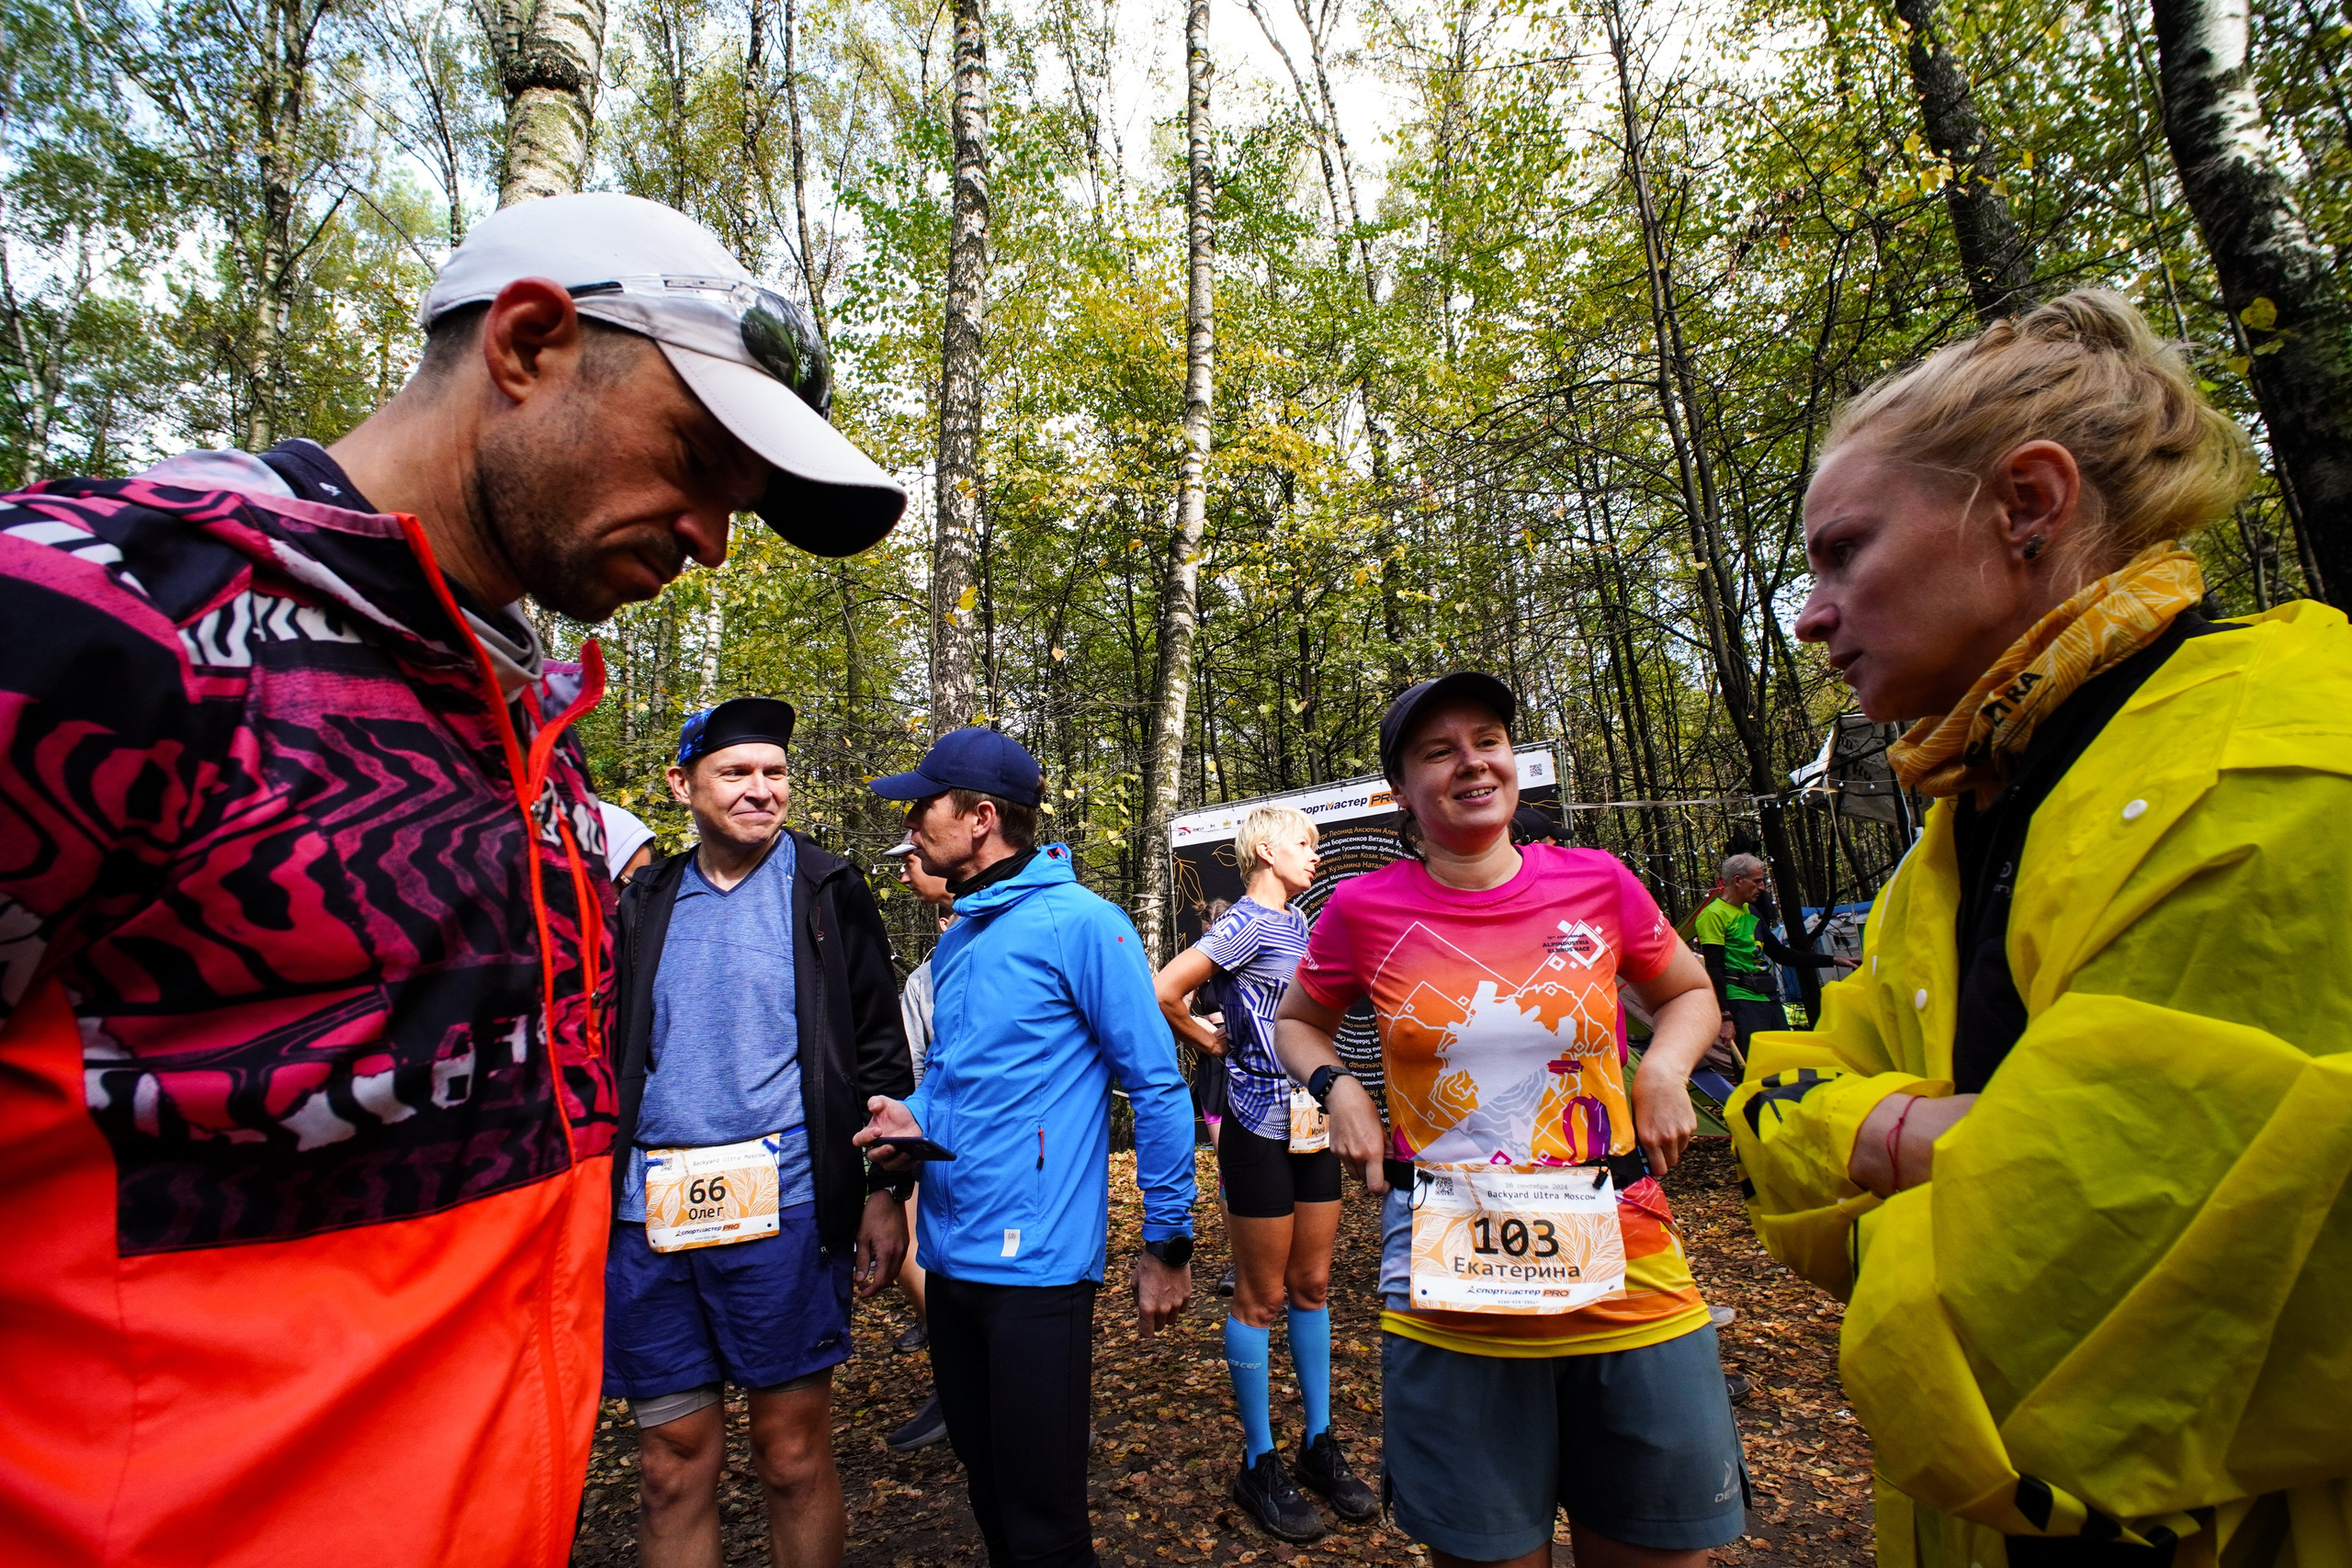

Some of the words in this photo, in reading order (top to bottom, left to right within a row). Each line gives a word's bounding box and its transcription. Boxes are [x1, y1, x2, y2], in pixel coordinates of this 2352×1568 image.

[1329, 829, 1353, 837] Леонид
[1331, 836, 1368, 846] Борисенков
[1369, 835, 1394, 845] Виталий
[1360, 852, 1379, 860] Козак
[1312, 869, 1328, 881] ьяна
[1329, 862, 1361, 874] Кузьмина
[1543, 940, 1589, 948] ALPINDUSTRIA
[689, 1176, 726, 1204] 66
[1487, 1190, 1529, 1201] Backyard
[1534, 1192, 1560, 1201] Ultra
[1565, 1193, 1597, 1201] Moscow
[688, 1206, 724, 1221] Олег
[722, 1224, 740, 1232] PRO
[1473, 1217, 1560, 1258] 103
[1454, 1257, 1580, 1281] Екатерина
